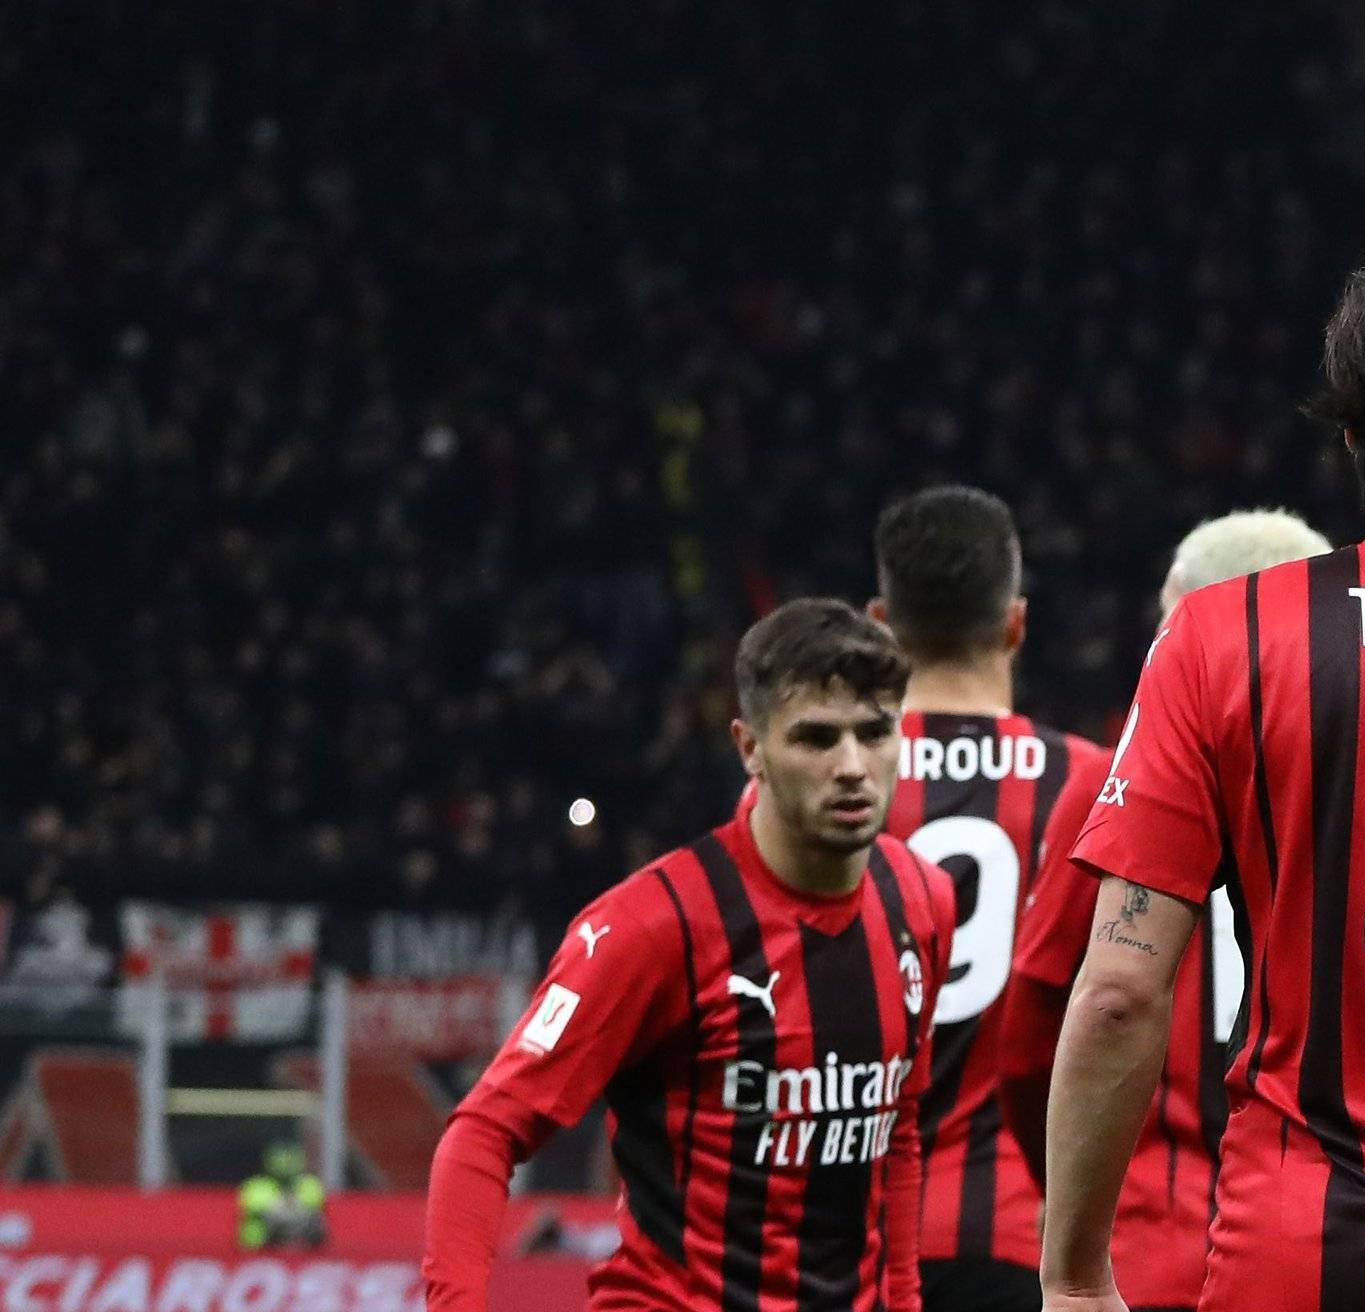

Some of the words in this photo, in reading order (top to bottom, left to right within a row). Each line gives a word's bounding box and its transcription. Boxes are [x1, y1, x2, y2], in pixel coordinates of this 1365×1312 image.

[905, 815, 1020, 1025] 9
[722, 1051, 913, 1113] Emirat
[755, 1120, 817, 1167] FLY
